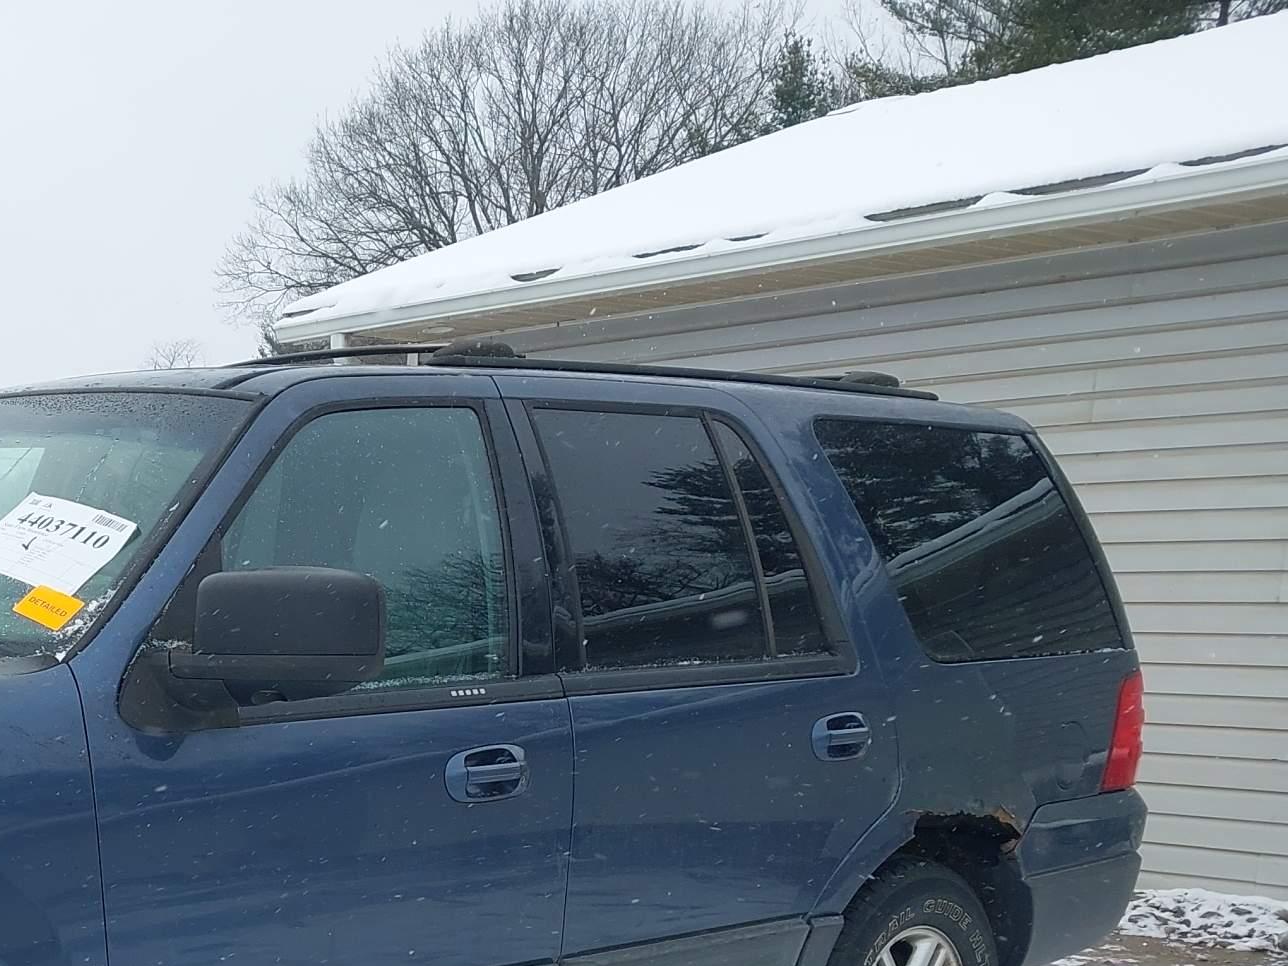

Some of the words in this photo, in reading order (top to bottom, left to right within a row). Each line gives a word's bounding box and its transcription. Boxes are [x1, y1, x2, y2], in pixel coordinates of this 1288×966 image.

[17, 512, 110, 549] 44037110
[28, 596, 68, 618] DETAILED
[864, 907, 915, 966] TRAIL
[923, 899, 972, 931] GUIDE
